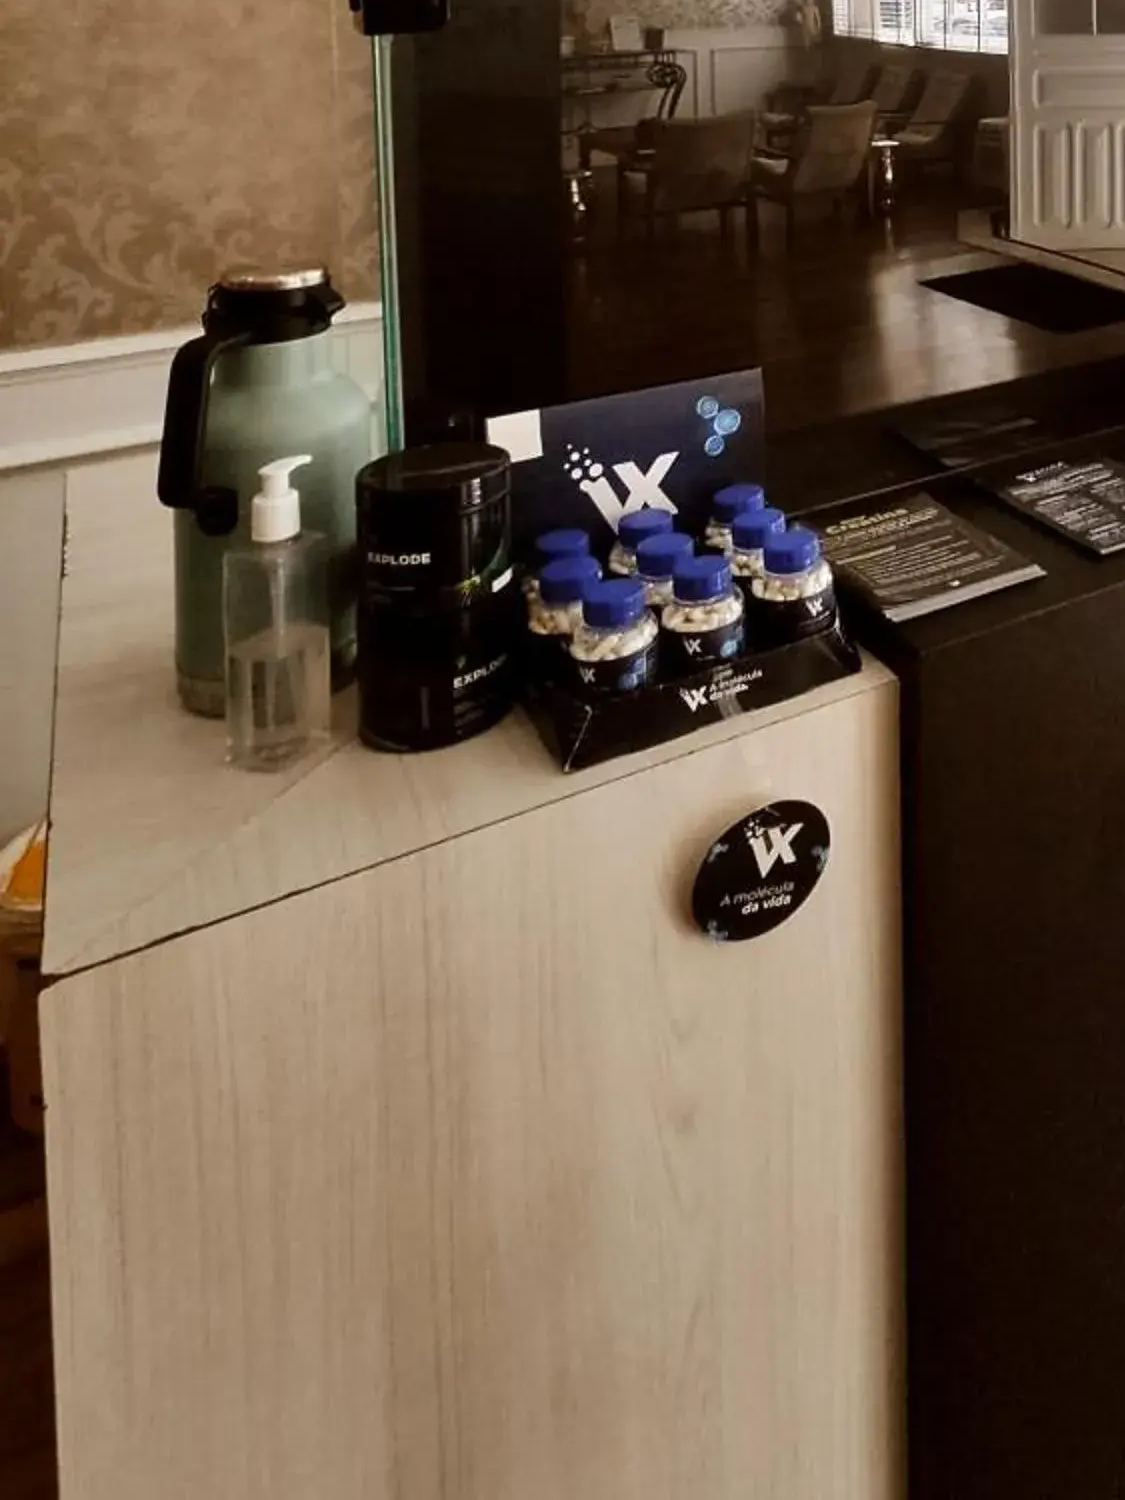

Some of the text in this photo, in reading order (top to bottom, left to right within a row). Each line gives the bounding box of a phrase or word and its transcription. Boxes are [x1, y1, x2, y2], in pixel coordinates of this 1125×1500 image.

[367, 552, 432, 566] EXPLODE
[720, 893, 731, 908] A
[741, 894, 791, 915] da vida
